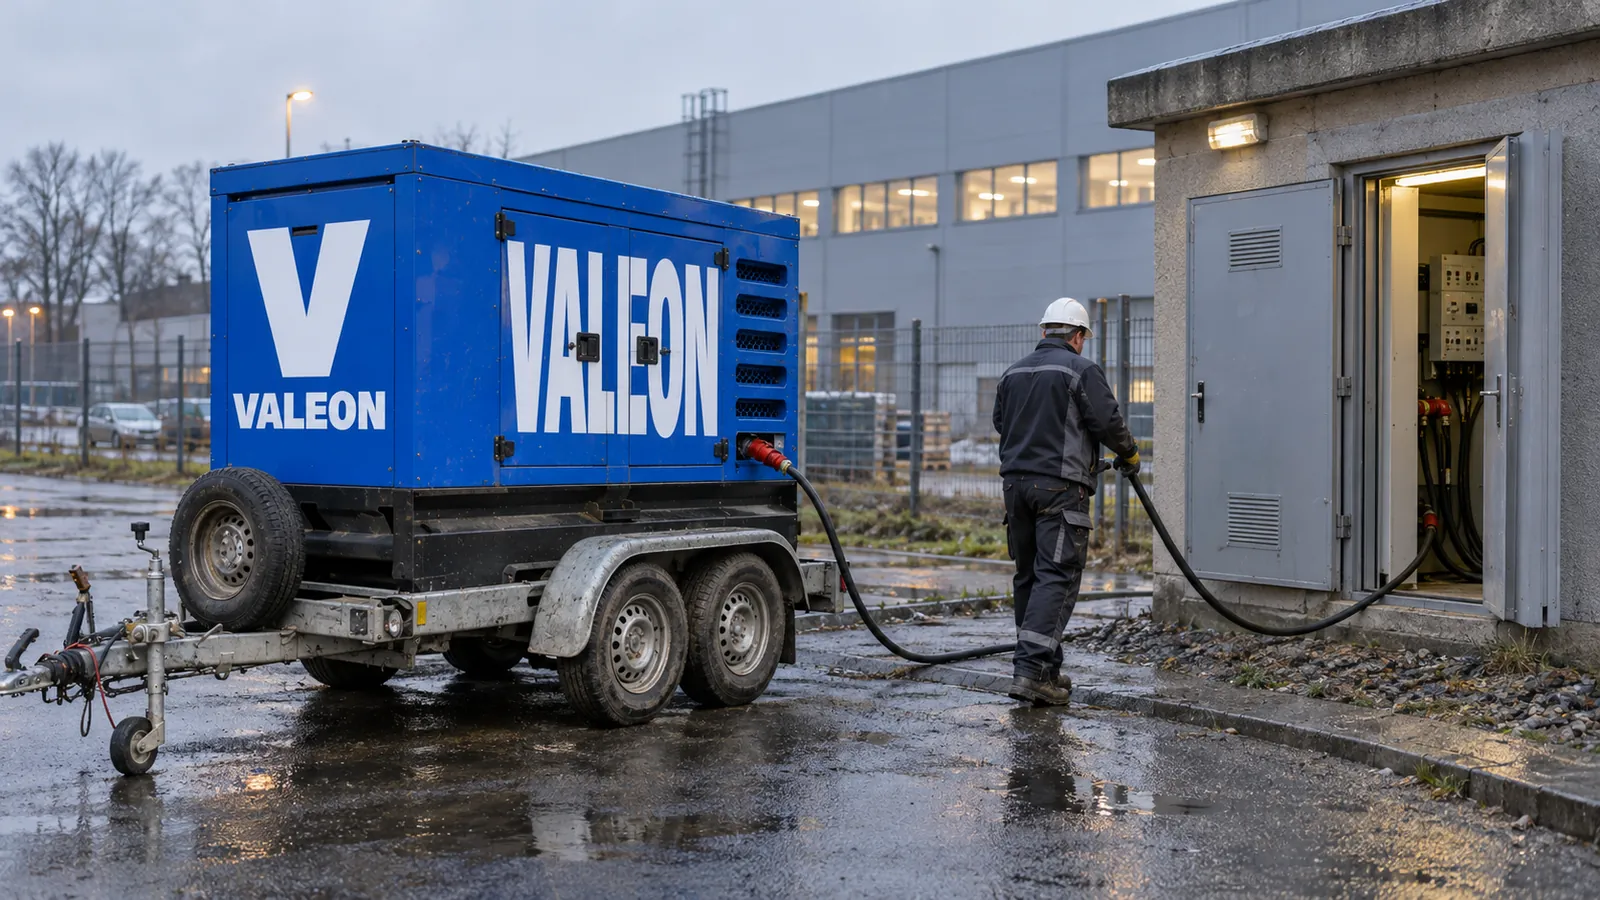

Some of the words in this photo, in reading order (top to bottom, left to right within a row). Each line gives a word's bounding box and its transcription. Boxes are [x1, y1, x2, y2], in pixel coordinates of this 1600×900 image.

[247, 220, 371, 378] V
[507, 240, 719, 439] VALEON
[233, 391, 386, 430] VALEON
